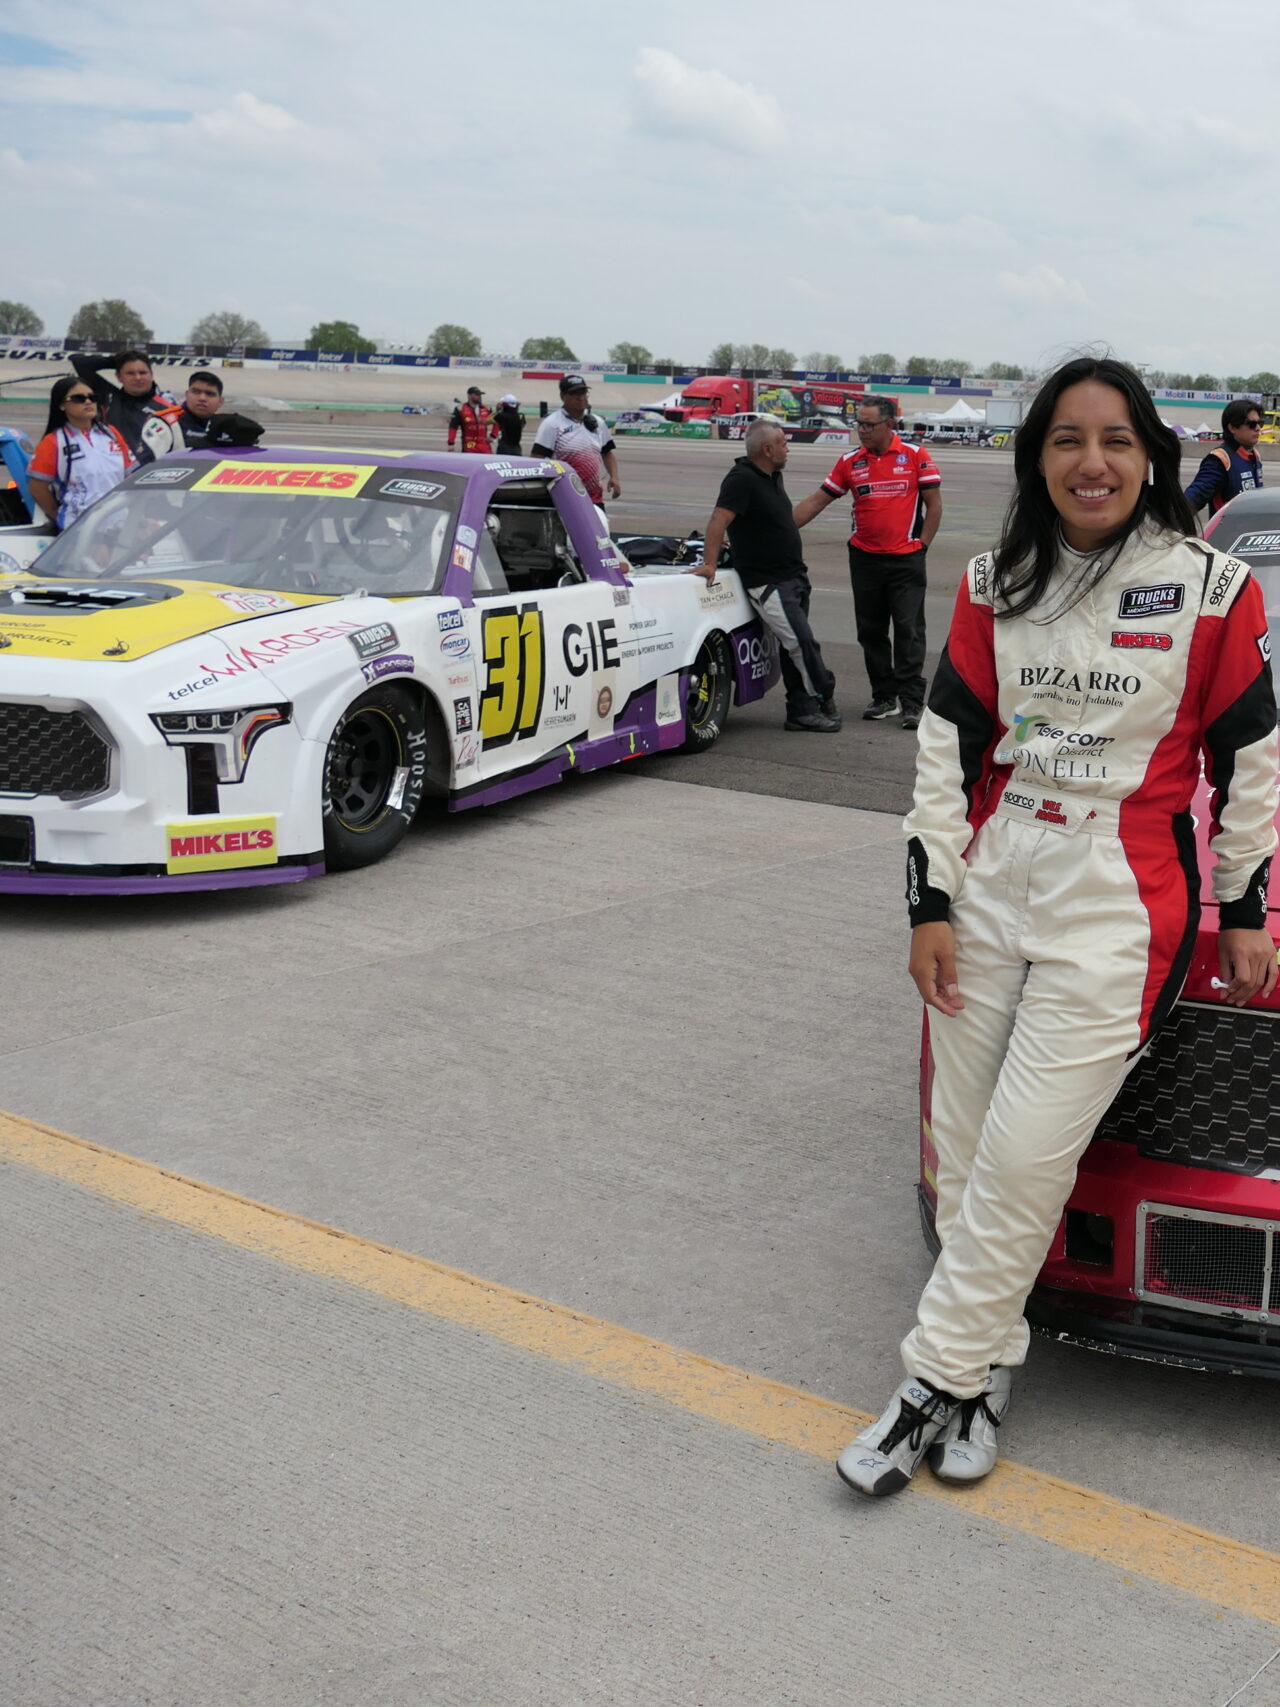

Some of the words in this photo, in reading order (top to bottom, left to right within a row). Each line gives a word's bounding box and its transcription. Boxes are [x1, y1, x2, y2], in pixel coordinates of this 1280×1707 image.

[209, 468, 359, 490] MIKEL'S
[394, 481, 436, 493] TRUCKS
[975, 554, 988, 595] sparco
[1209, 558, 1239, 605] sparco
[1130, 588, 1176, 606] TRUCKS
[440, 613, 462, 630] telcel
[7, 632, 75, 646] PROJECTS
[354, 623, 392, 647] TRUCKS
[443, 639, 468, 650] moncar
[563, 619, 621, 678] CIE
[480, 603, 544, 745] 31
[751, 660, 772, 680] ZERO
[1019, 666, 1142, 695] BIZZARRO
[168, 672, 219, 702] telcel
[1057, 745, 1105, 758] District
[402, 729, 428, 825] Hoosier
[1004, 791, 1035, 808] sparco
[170, 829, 274, 858] MIKEL'S
